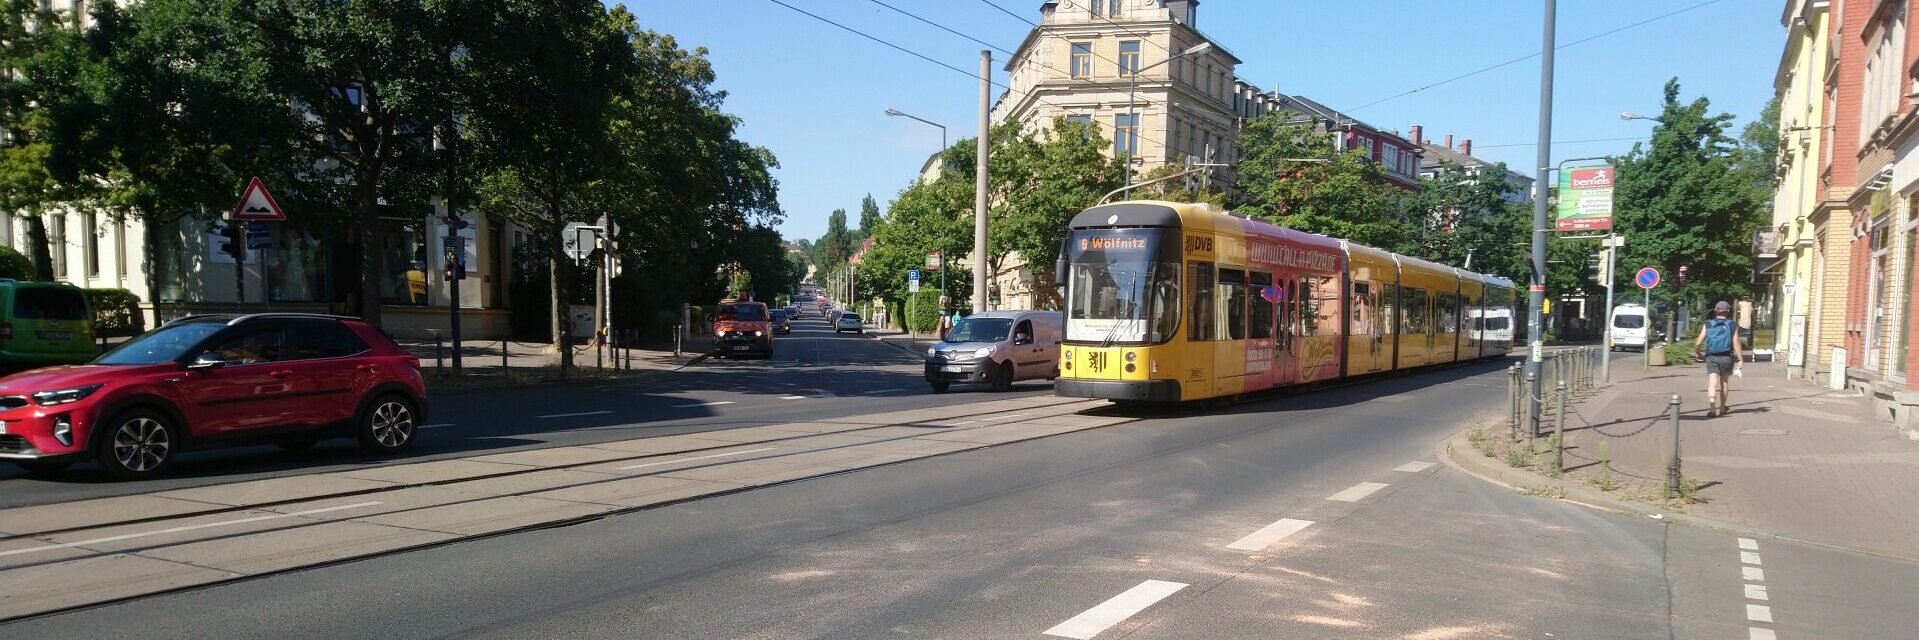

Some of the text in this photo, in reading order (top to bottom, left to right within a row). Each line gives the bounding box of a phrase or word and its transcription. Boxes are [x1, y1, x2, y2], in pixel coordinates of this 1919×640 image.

[1081, 237, 1145, 251] 6 Wölfnitz
[1195, 236, 1213, 251] DVB
